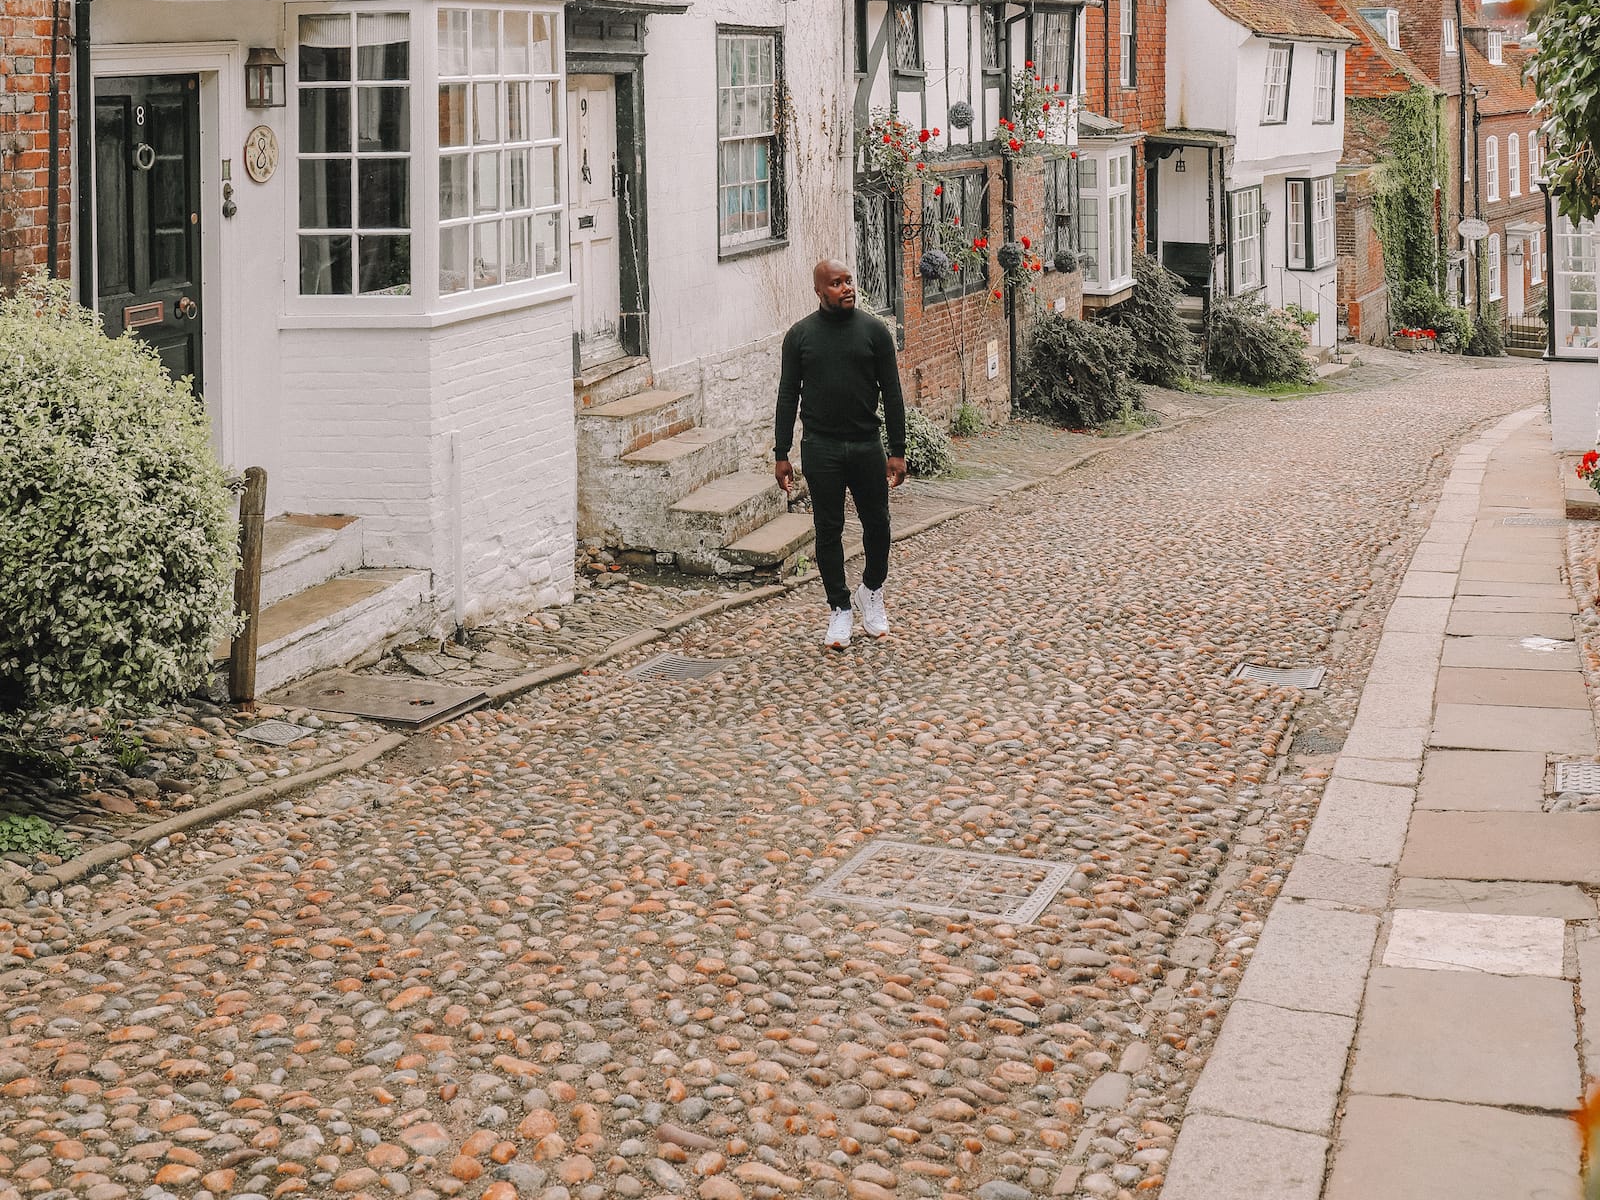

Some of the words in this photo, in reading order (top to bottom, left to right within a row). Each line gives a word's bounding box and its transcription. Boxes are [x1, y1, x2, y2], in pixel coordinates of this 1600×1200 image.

[136, 105, 145, 126] 8
[580, 98, 588, 117] 9
[256, 137, 267, 169] 8
